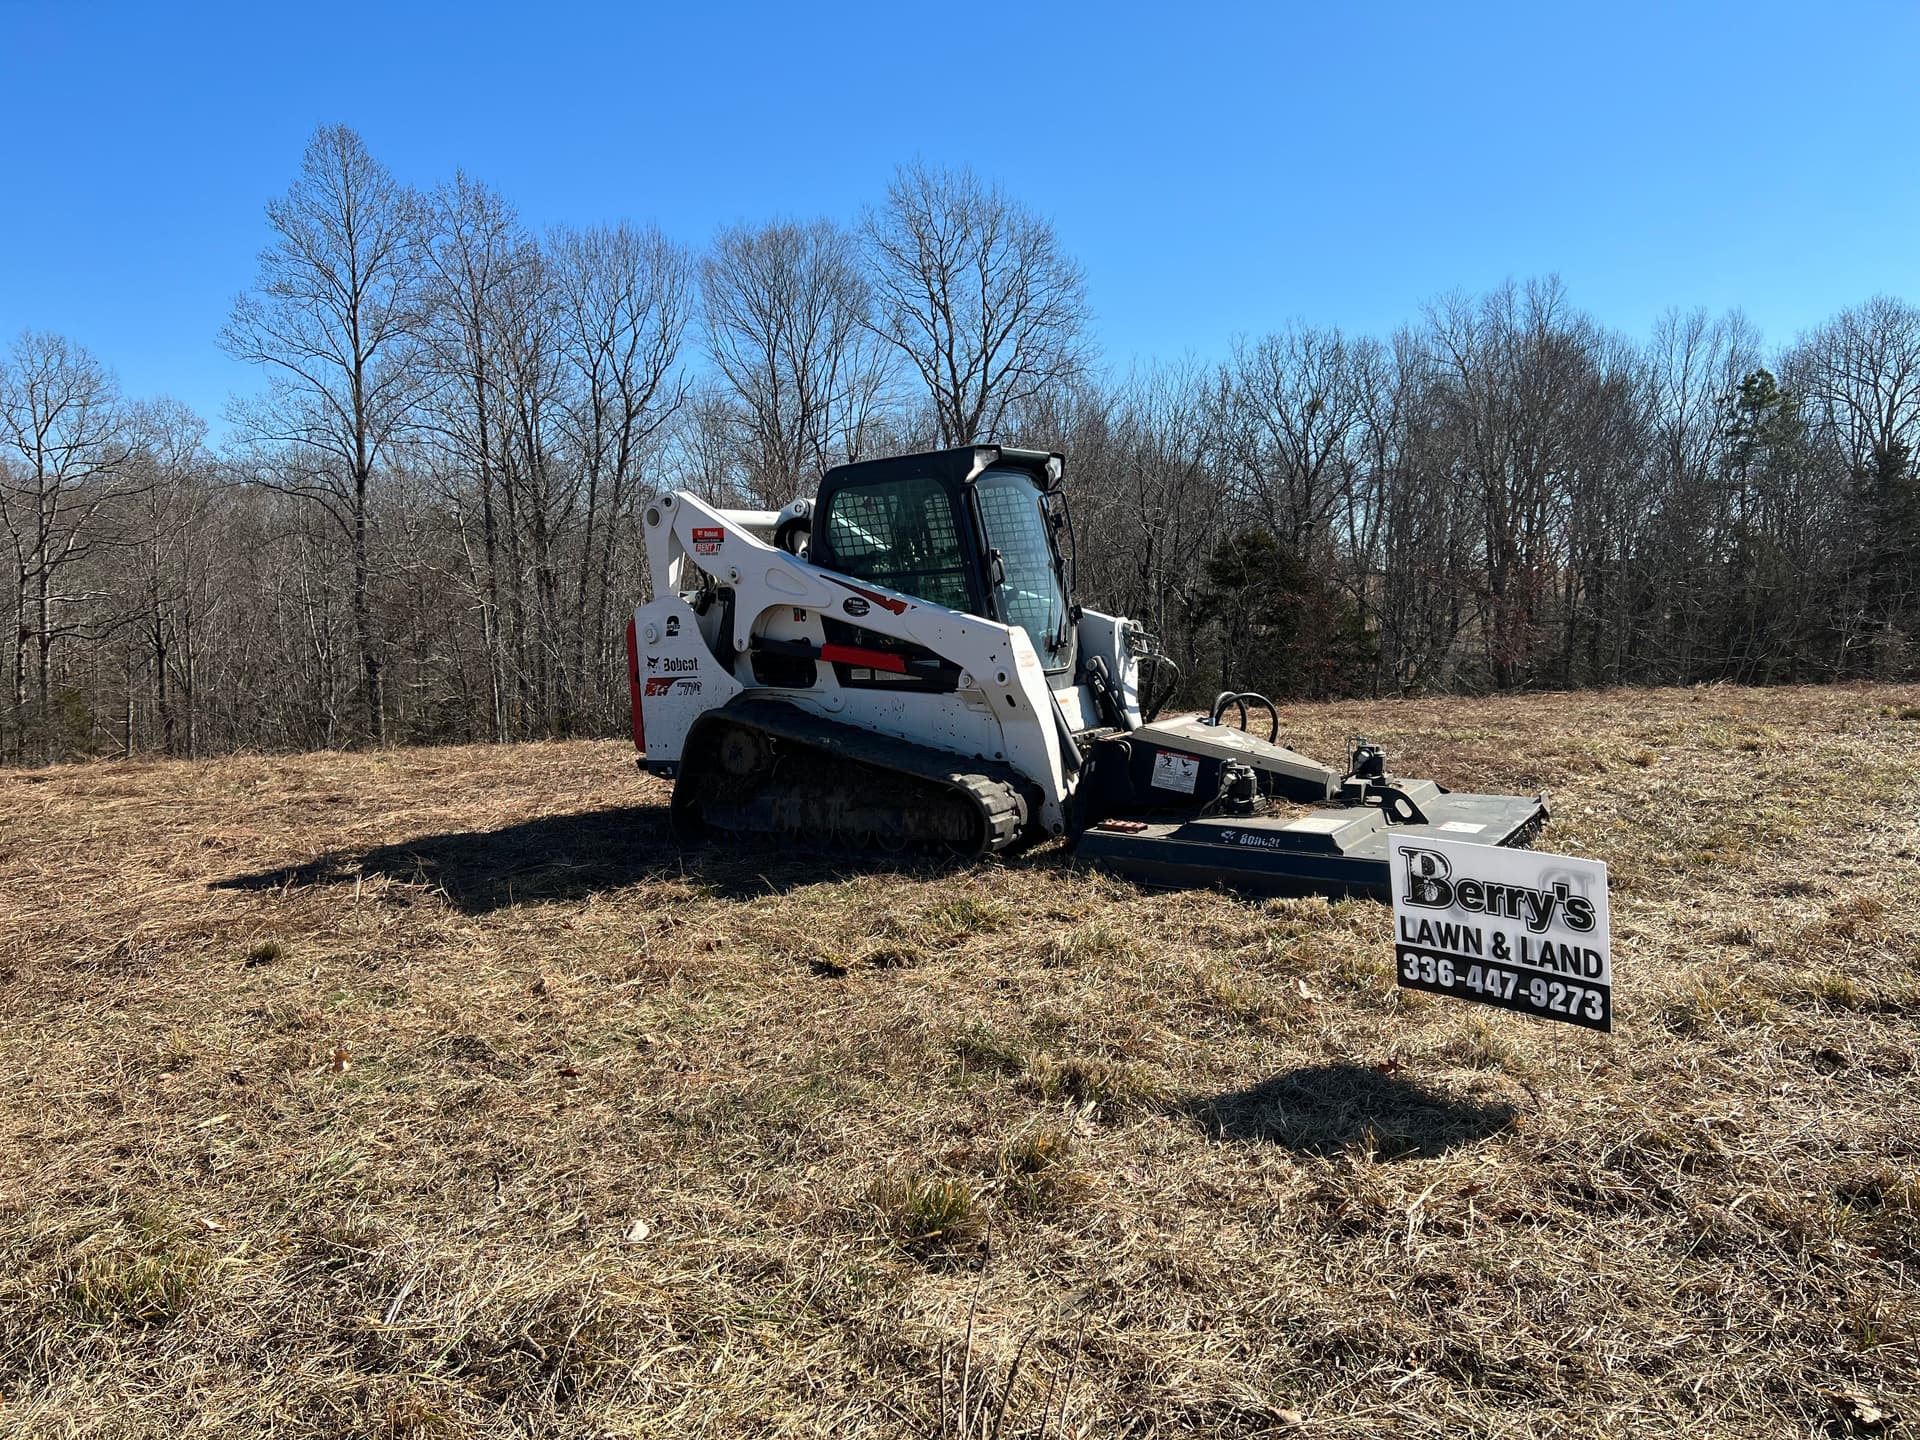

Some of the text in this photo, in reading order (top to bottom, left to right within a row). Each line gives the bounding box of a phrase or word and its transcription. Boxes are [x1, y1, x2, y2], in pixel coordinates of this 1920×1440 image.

[663, 657, 698, 672] Bobcat
[1398, 846, 1597, 933] Berry's
[1399, 915, 1604, 979] LAWN & LAND
[1402, 953, 1604, 1021] 336-447-9273
